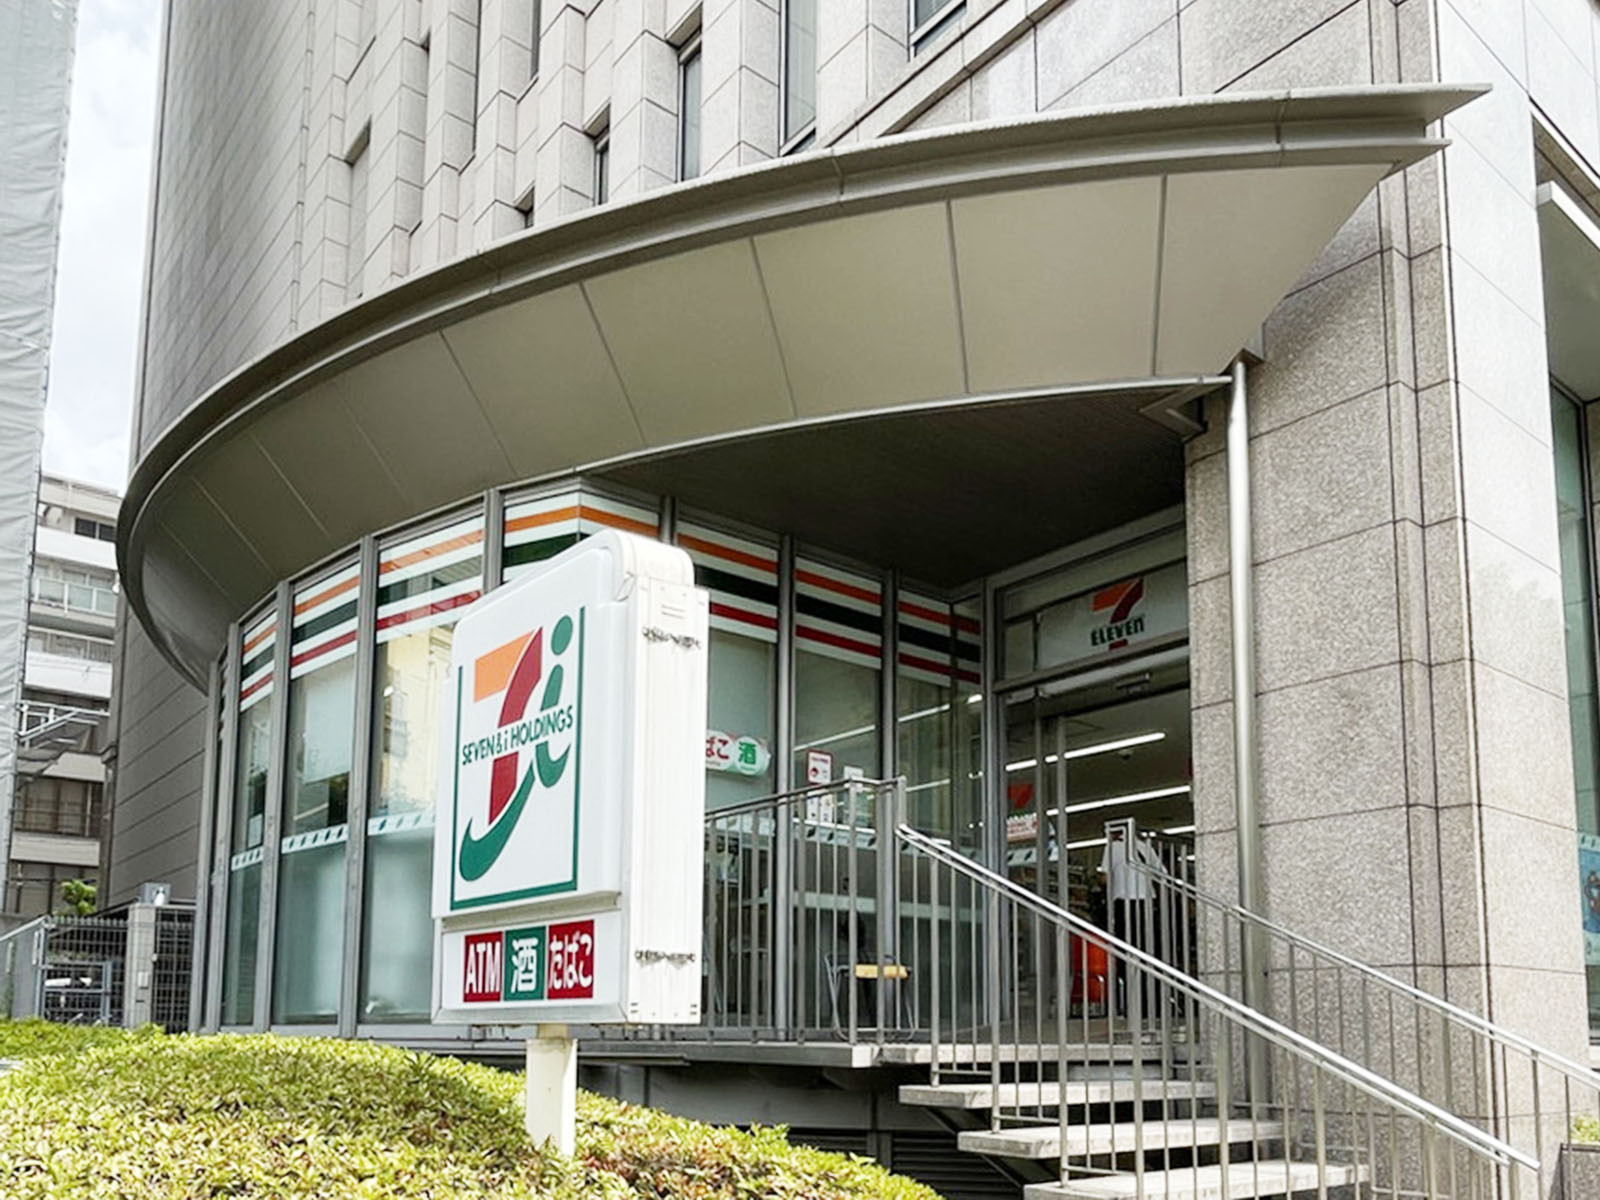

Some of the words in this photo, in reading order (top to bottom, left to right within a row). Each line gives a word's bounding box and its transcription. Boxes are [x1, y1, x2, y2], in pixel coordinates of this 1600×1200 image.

[510, 705, 573, 748] HOLDINGS
[706, 737, 729, 759] ばこ
[738, 741, 757, 765] 酒
[465, 941, 501, 993] ATM
[510, 937, 538, 993] 酒
[549, 930, 593, 989] たばこ
